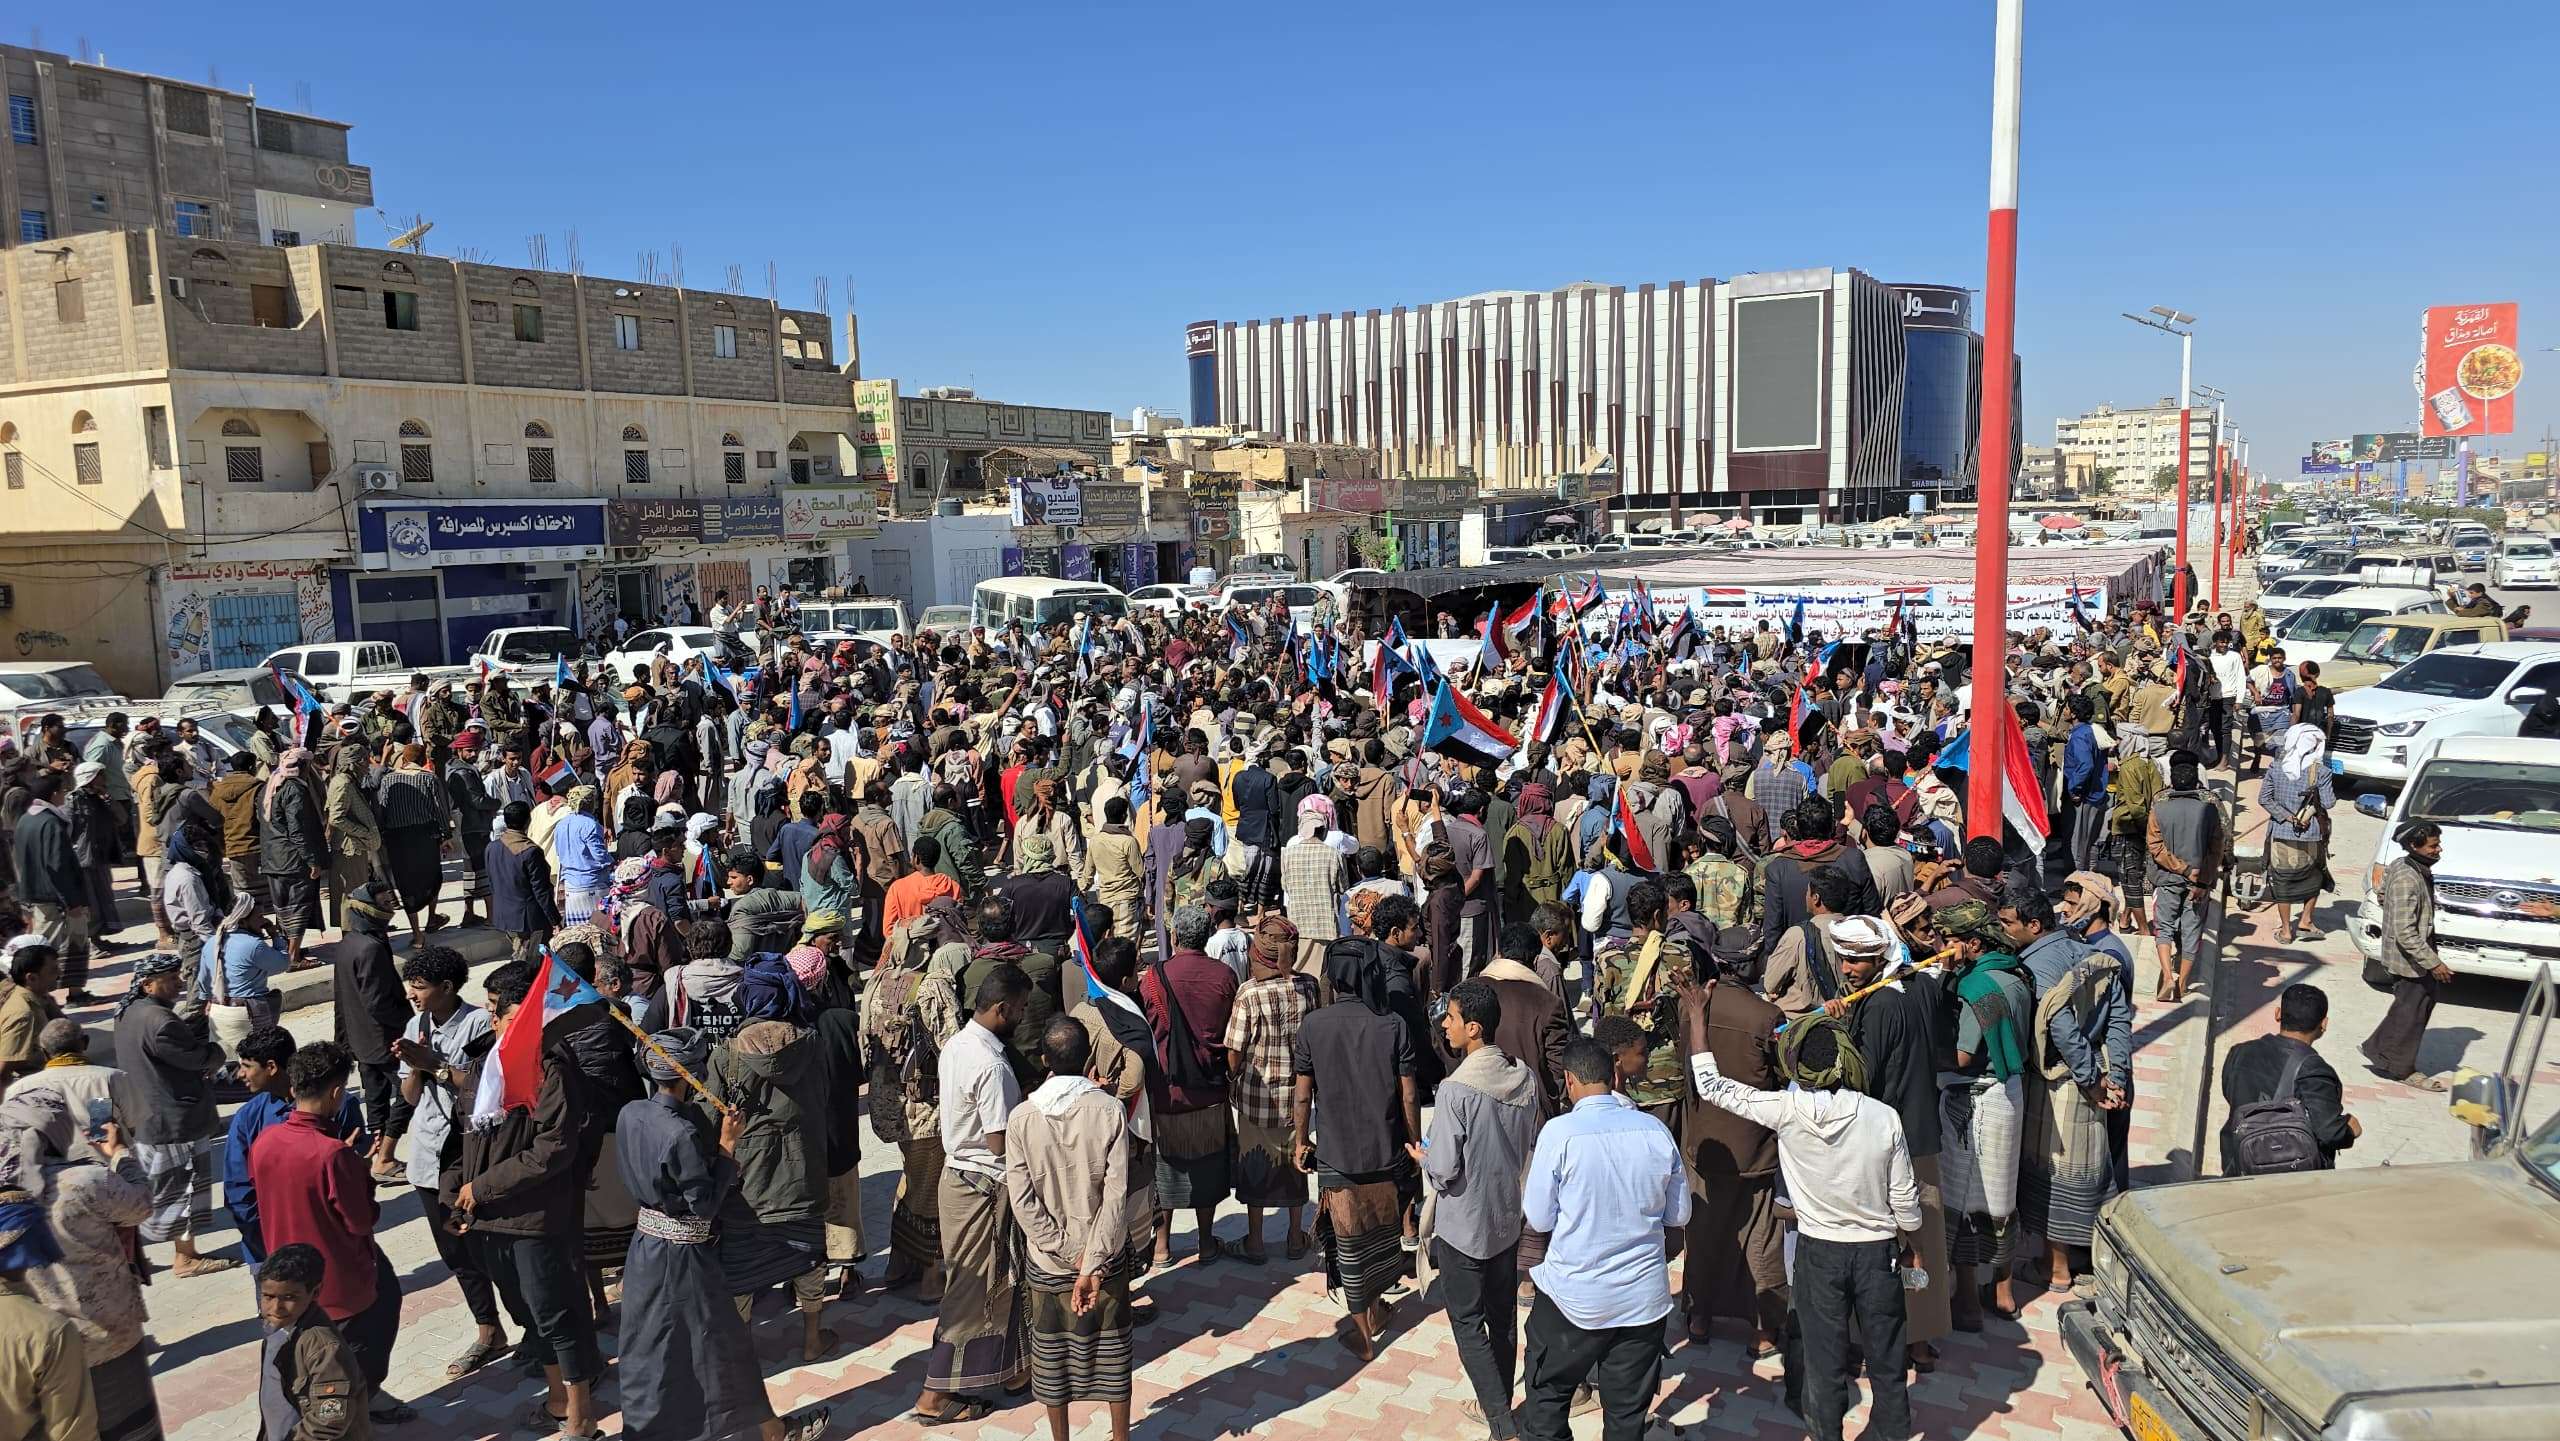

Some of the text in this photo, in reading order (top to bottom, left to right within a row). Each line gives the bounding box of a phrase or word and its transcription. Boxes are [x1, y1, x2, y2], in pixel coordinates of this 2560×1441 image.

[640, 502, 666, 521] الأمل
[668, 504, 699, 521] معامل
[724, 503, 780, 519] مركز الأمل
[437, 516, 485, 537] للصرافة
[486, 516, 532, 536] اكسبرس
[213, 563, 245, 583] وادي
[245, 561, 289, 580] ماركت
